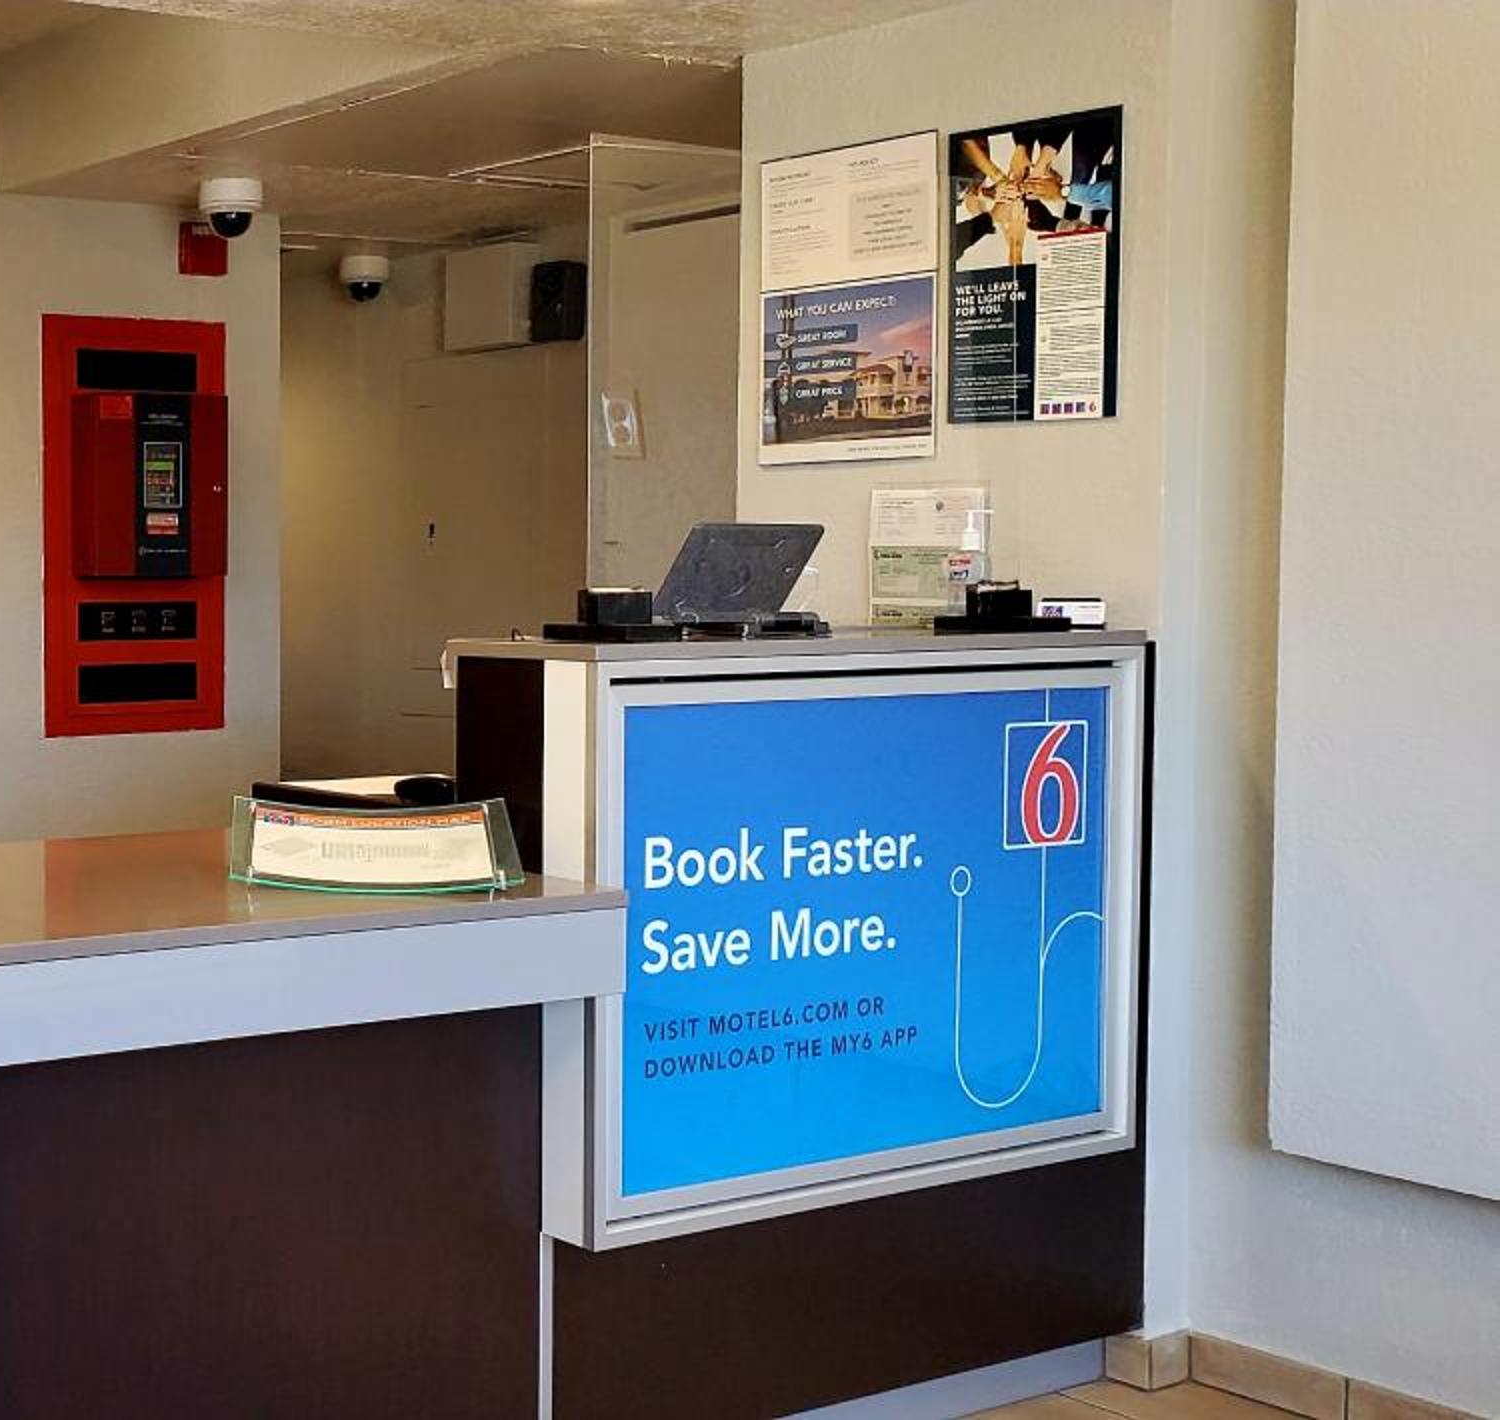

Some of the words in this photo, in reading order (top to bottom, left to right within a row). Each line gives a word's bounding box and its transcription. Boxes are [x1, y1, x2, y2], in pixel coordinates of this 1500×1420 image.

[955, 284, 985, 295] WE'LL
[988, 280, 1019, 292] LEAVE
[955, 297, 975, 307] THE
[978, 293, 1007, 305] LIGHT
[1009, 291, 1027, 302] ON
[775, 307, 803, 320] WHAT
[807, 303, 827, 316] YOU
[829, 300, 852, 314] CAN
[955, 307, 977, 317] FOR
[797, 332, 820, 344] GREAT
[822, 329, 847, 341] ROOM
[795, 360, 820, 371] GREAT
[822, 357, 853, 369] SERVICE
[795, 388, 820, 399] GREAT
[822, 386, 843, 397] PRICE
[1021, 723, 1080, 845] 6
[644, 827, 765, 890] Book
[782, 827, 924, 879] Faster.
[641, 919, 751, 975] Save
[770, 908, 896, 961] More.
[644, 1018, 700, 1043] VISIT
[709, 1000, 849, 1035] MOTEL6.COM
[857, 997, 885, 1017] OR
[644, 1045, 776, 1080] DOWNLOAD
[784, 1039, 823, 1059] THE
[831, 1032, 873, 1056] MY6
[881, 1025, 918, 1047] APP
